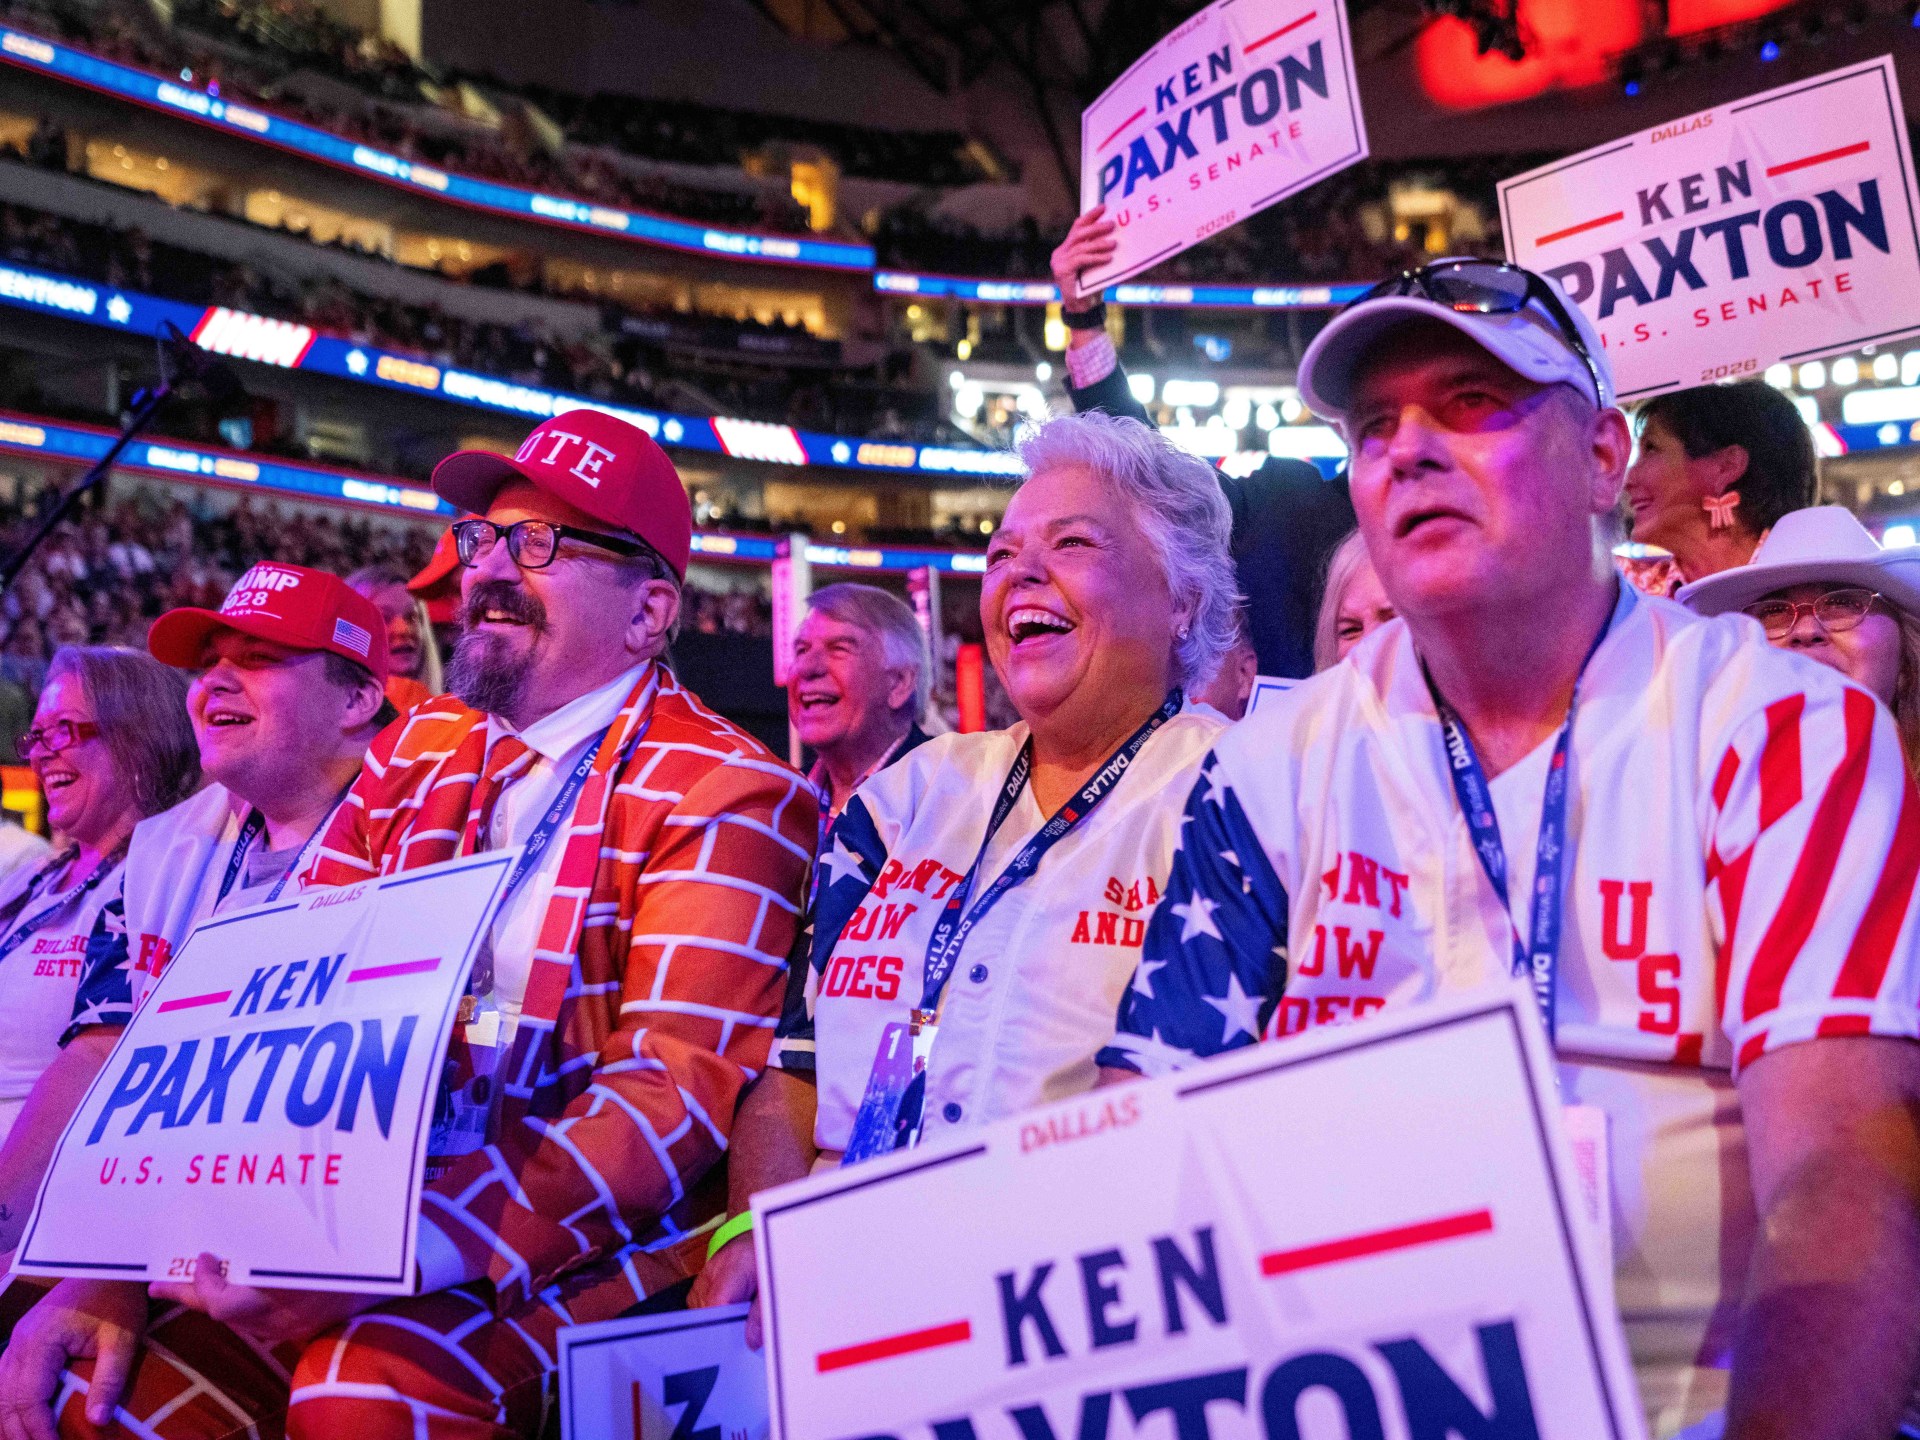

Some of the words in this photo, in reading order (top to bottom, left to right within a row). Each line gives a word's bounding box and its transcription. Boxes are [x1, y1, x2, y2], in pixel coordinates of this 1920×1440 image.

[1155, 44, 1232, 114] KEN
[1097, 39, 1330, 205] PAXTON
[1650, 114, 1714, 144] DALLAS
[1116, 194, 1172, 227] U.S.
[1188, 121, 1303, 191] SENATE
[1636, 159, 1753, 227] KEN
[1542, 178, 1891, 320] PAXTON
[1693, 273, 1853, 327] SENATE
[1701, 358, 1758, 381] 2026
[514, 429, 616, 488] OTE
[231, 571, 300, 592] UMP
[555, 782, 577, 812] WinRed
[1082, 753, 1130, 804] DALLAS
[233, 823, 256, 868] DALLAS
[308, 885, 368, 911] DALLAS
[932, 920, 973, 980] DALLAS
[229, 952, 348, 1018] KEN
[84, 1014, 419, 1147] PAXTON
[1019, 1095, 1142, 1155] DALLAS
[100, 1155, 163, 1186] U.S.
[185, 1153, 343, 1186] SENATE
[168, 1258, 230, 1279] 206
[995, 1223, 1231, 1369] KEN
